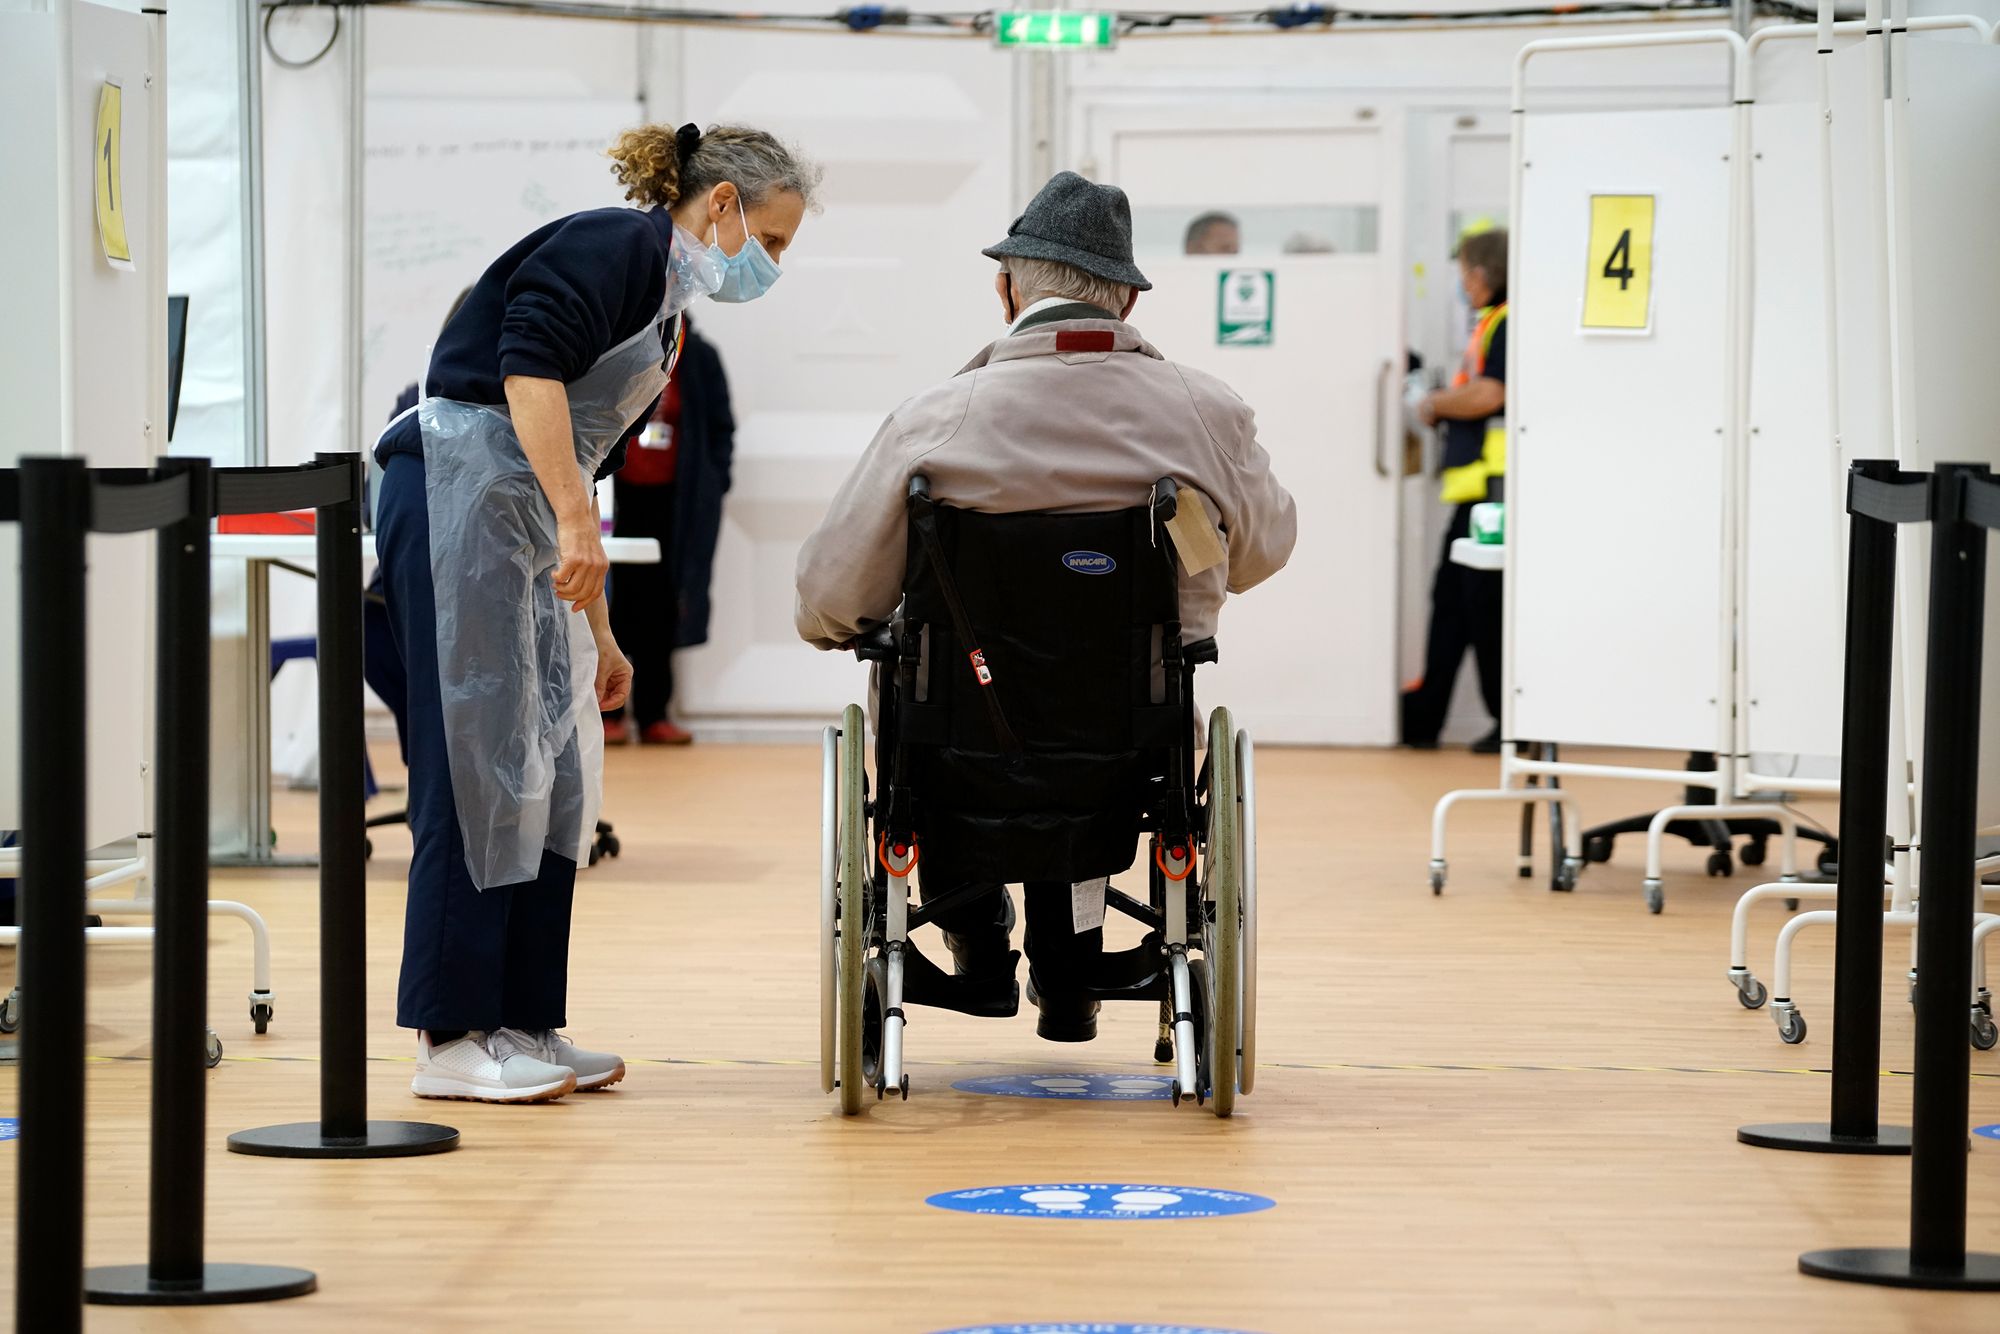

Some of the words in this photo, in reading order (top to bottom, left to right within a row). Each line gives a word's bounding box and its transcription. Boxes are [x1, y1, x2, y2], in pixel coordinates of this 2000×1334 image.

[103, 128, 114, 211] 1
[1603, 228, 1635, 291] 4
[1069, 557, 1108, 566] INVACARE
